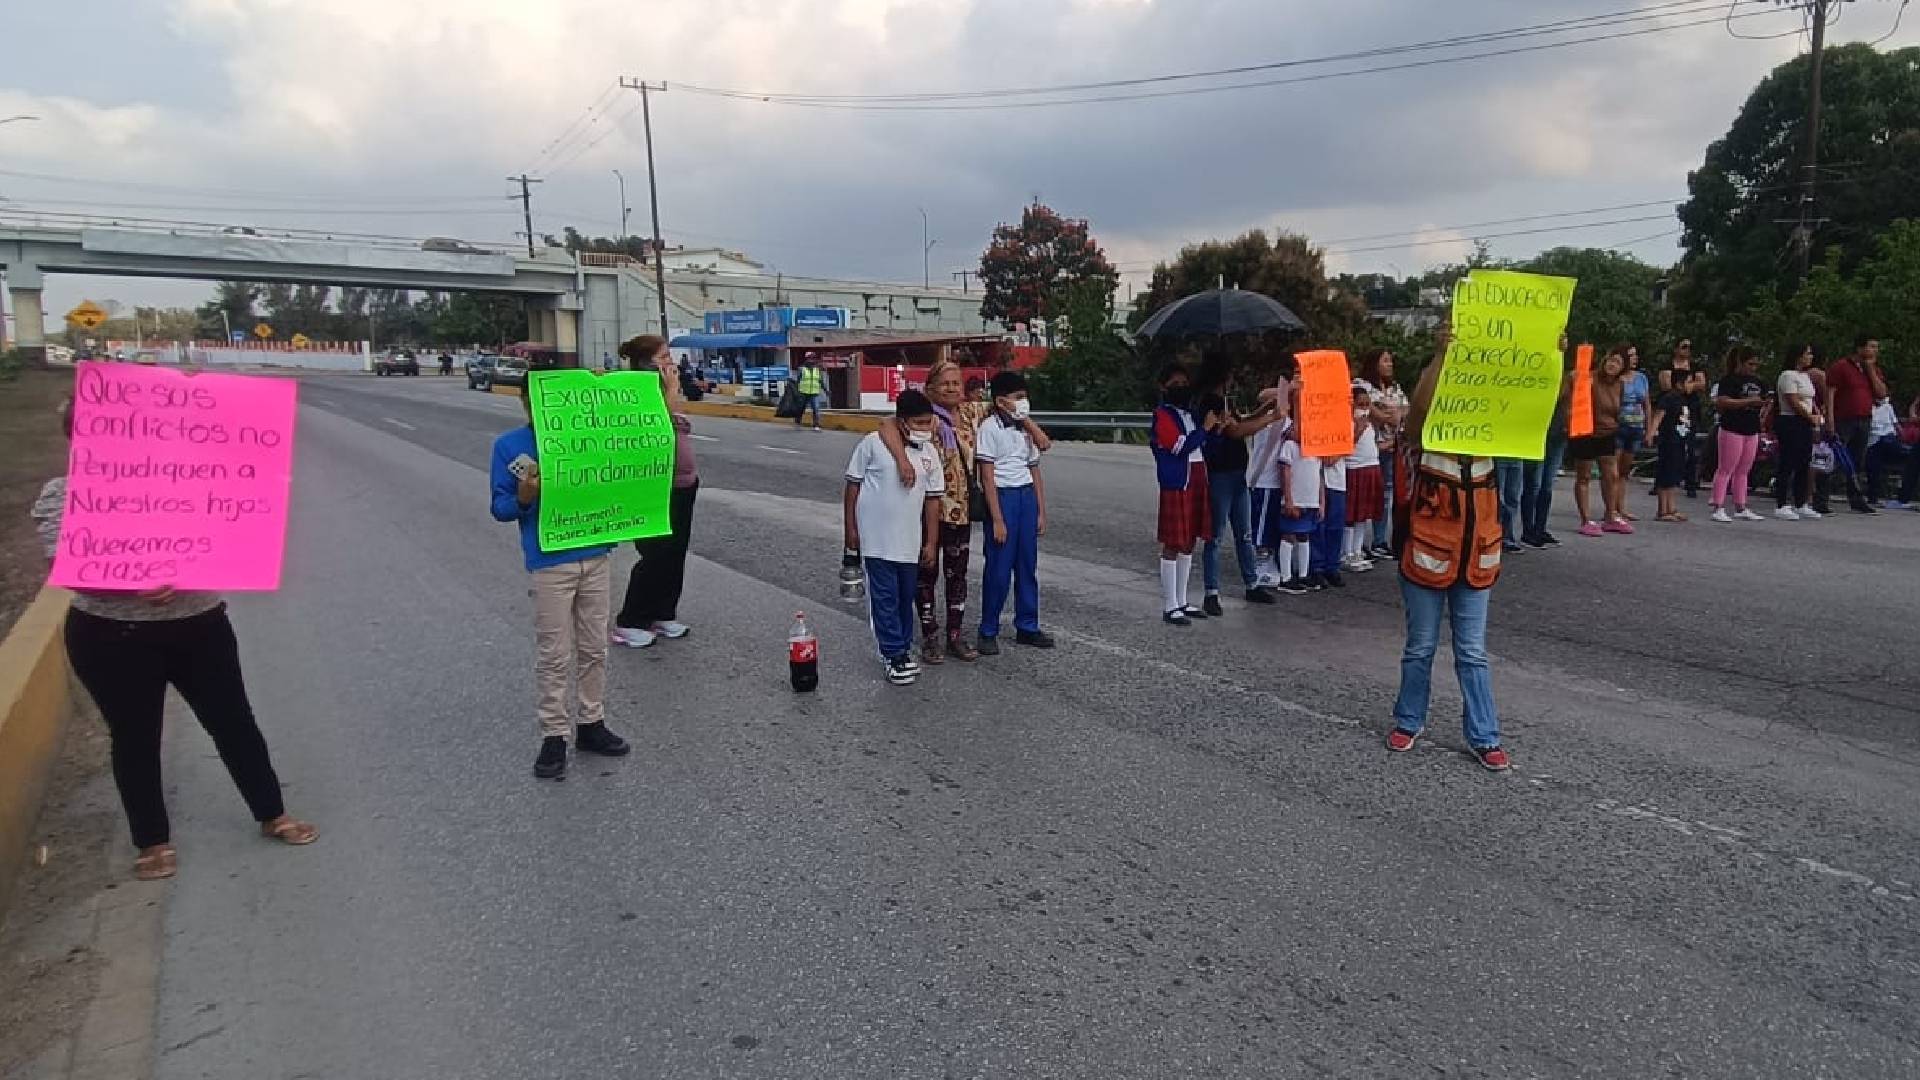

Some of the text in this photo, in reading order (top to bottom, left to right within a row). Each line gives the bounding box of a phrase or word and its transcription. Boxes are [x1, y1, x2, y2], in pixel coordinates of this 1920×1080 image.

[79, 368, 217, 409] Que sus
[539, 376, 639, 414] Exigimos
[239, 426, 281, 448] no
[570, 437, 598, 454] un
[604, 432, 671, 451] derecho
[238, 463, 256, 479] a
[69, 488, 196, 515] Nuestros
